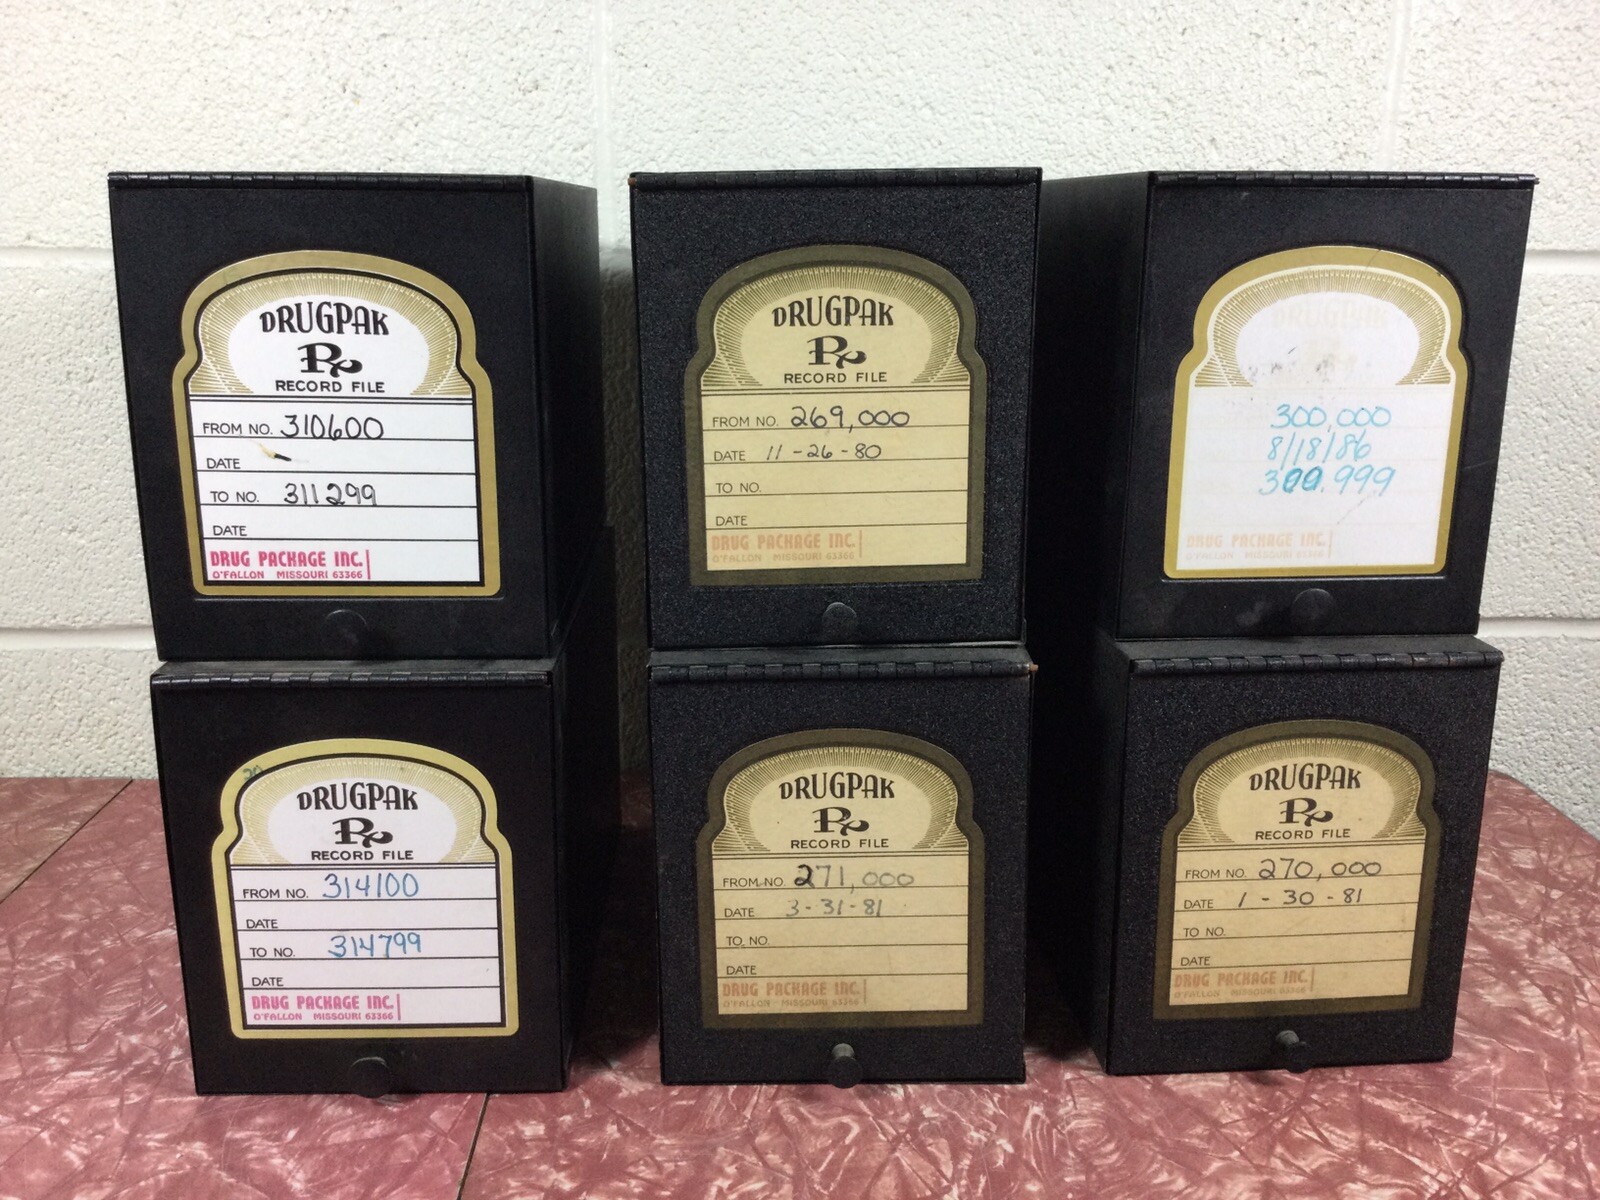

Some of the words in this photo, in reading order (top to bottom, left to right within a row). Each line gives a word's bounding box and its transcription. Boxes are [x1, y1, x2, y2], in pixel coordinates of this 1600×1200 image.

[772, 295, 894, 327] DRUGPAK
[259, 301, 389, 336] DRUGPAK
[784, 373, 847, 384] RECORD
[856, 372, 887, 383] FILE
[276, 380, 342, 393] RECORD
[352, 381, 385, 393] FILE
[712, 417, 750, 428] FROM
[756, 416, 779, 427] NO.
[791, 405, 910, 433] 269,000
[202, 423, 242, 434] FROM
[248, 424, 273, 435] NO.
[280, 414, 384, 441] 310600
[714, 451, 746, 461] DATE
[206, 458, 241, 469] DATE
[716, 483, 733, 493] TO
[740, 482, 762, 493] NO.
[210, 491, 231, 502] TO
[236, 491, 259, 503] NO.
[284, 482, 377, 507] 311299
[715, 516, 747, 526] DATE
[213, 525, 247, 536] DATE
[711, 534, 749, 550] DRUG
[757, 533, 821, 549] PACKAGE
[210, 551, 250, 567] DRUG
[258, 551, 326, 567] PACKAGE
[773, 552, 822, 561] MISSOURI
[212, 571, 265, 579] O'FALLON
[276, 571, 328, 579] MISSOURI
[332, 571, 363, 579] 63366
[1249, 762, 1362, 791] DRUGPAK
[778, 771, 895, 800] DRUGPAK
[297, 782, 418, 811] DRUGPAK
[1255, 830, 1313, 840] RECORD
[1322, 829, 1350, 838] FILE
[790, 839, 851, 849] RECORD
[859, 838, 889, 848] FILE
[311, 850, 374, 861] RECORD
[382, 850, 414, 860] FILE
[1185, 869, 1220, 879] FROM
[1226, 868, 1246, 878] NO.
[1258, 858, 1382, 881] 270,000
[722, 877, 759, 887] FROM
[764, 877, 785, 887] NO.
[794, 864, 914, 894] 271,000
[322, 872, 419, 899] 314100
[243, 889, 280, 898] FROM
[286, 888, 309, 898] NO.
[1183, 899, 1213, 909] DATE
[724, 907, 754, 917] DATE
[246, 919, 278, 929] DATE
[1183, 928, 1199, 937] TO
[1206, 927, 1226, 936] NO.
[328, 932, 422, 958] 314799
[726, 936, 742, 945] TO
[749, 936, 769, 945] NO.
[250, 948, 267, 957] TO
[274, 947, 295, 957] NO.
[1181, 956, 1210, 966] DATE
[726, 965, 757, 975] DATE
[252, 977, 284, 986] DATE
[1174, 973, 1211, 988] DRUG
[1217, 971, 1276, 986] PACKAGE
[722, 982, 758, 996] DRUG
[767, 982, 825, 996] PACKAGE
[251, 996, 289, 1010] DRUG
[296, 995, 360, 1010] PACKAGE
[254, 1013, 303, 1021] O'FALLON
[313, 1012, 361, 1020] MISSOURI
[365, 1012, 393, 1020] 63366
